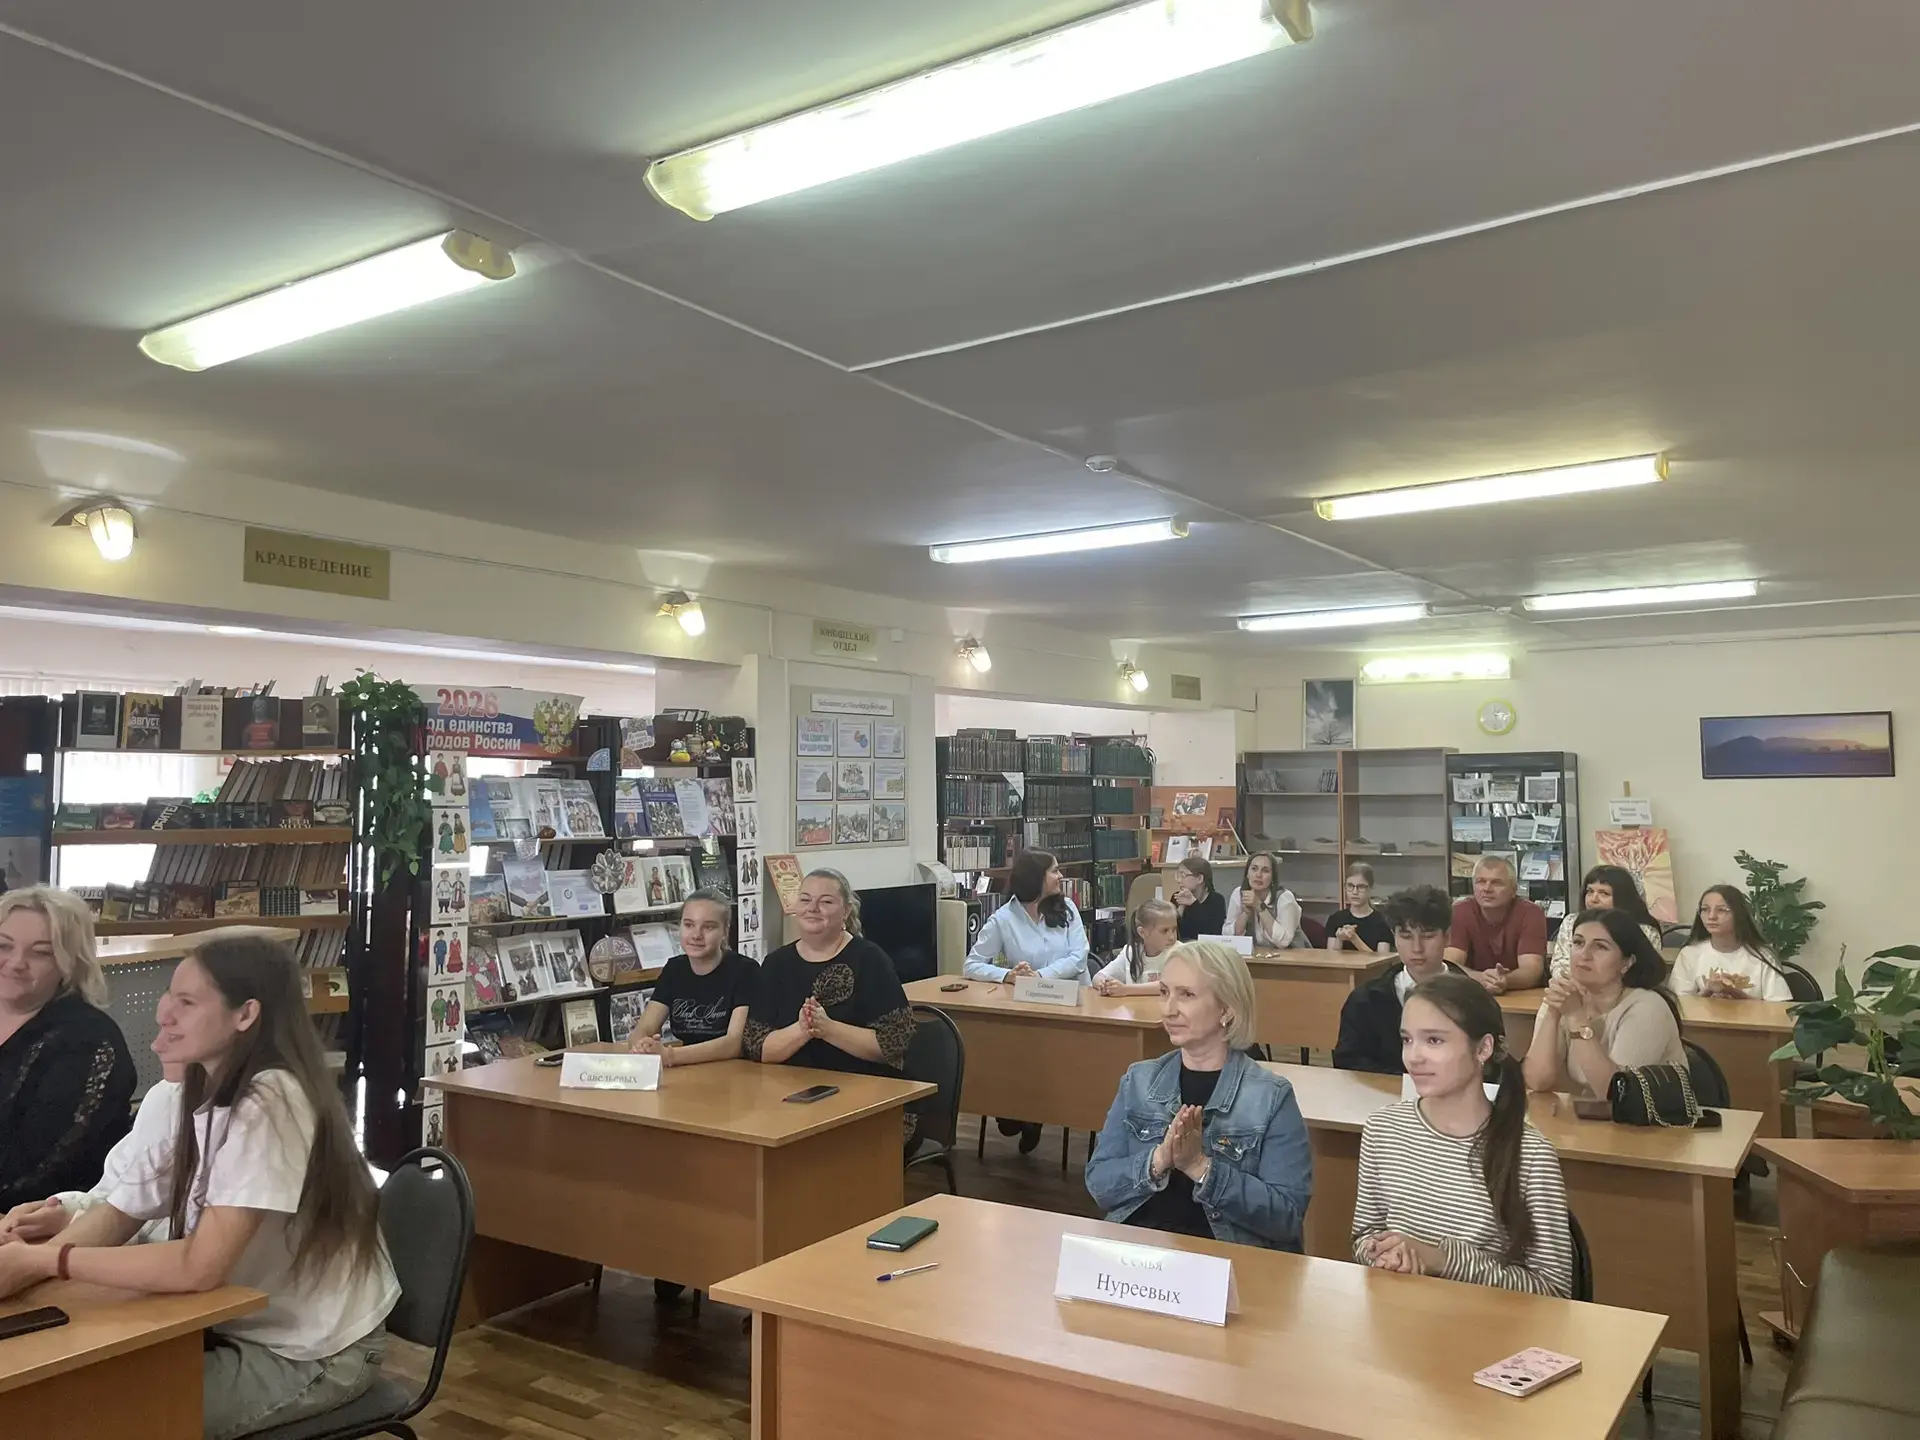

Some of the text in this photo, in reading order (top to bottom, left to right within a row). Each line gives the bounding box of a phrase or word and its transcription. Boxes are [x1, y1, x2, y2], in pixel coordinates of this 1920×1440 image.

[255, 550, 372, 579] КРАЕВЕДЕНИЕ
[820, 627, 870, 642] ЮНОШЕСКИЙ
[833, 640, 858, 652] ОТДЕЛ
[437, 689, 499, 718] 2026
[427, 718, 514, 735] од единства
[427, 735, 522, 751] родов России
[579, 1072, 638, 1084] Савельевых
[1096, 1273, 1182, 1304] Нуреевых
